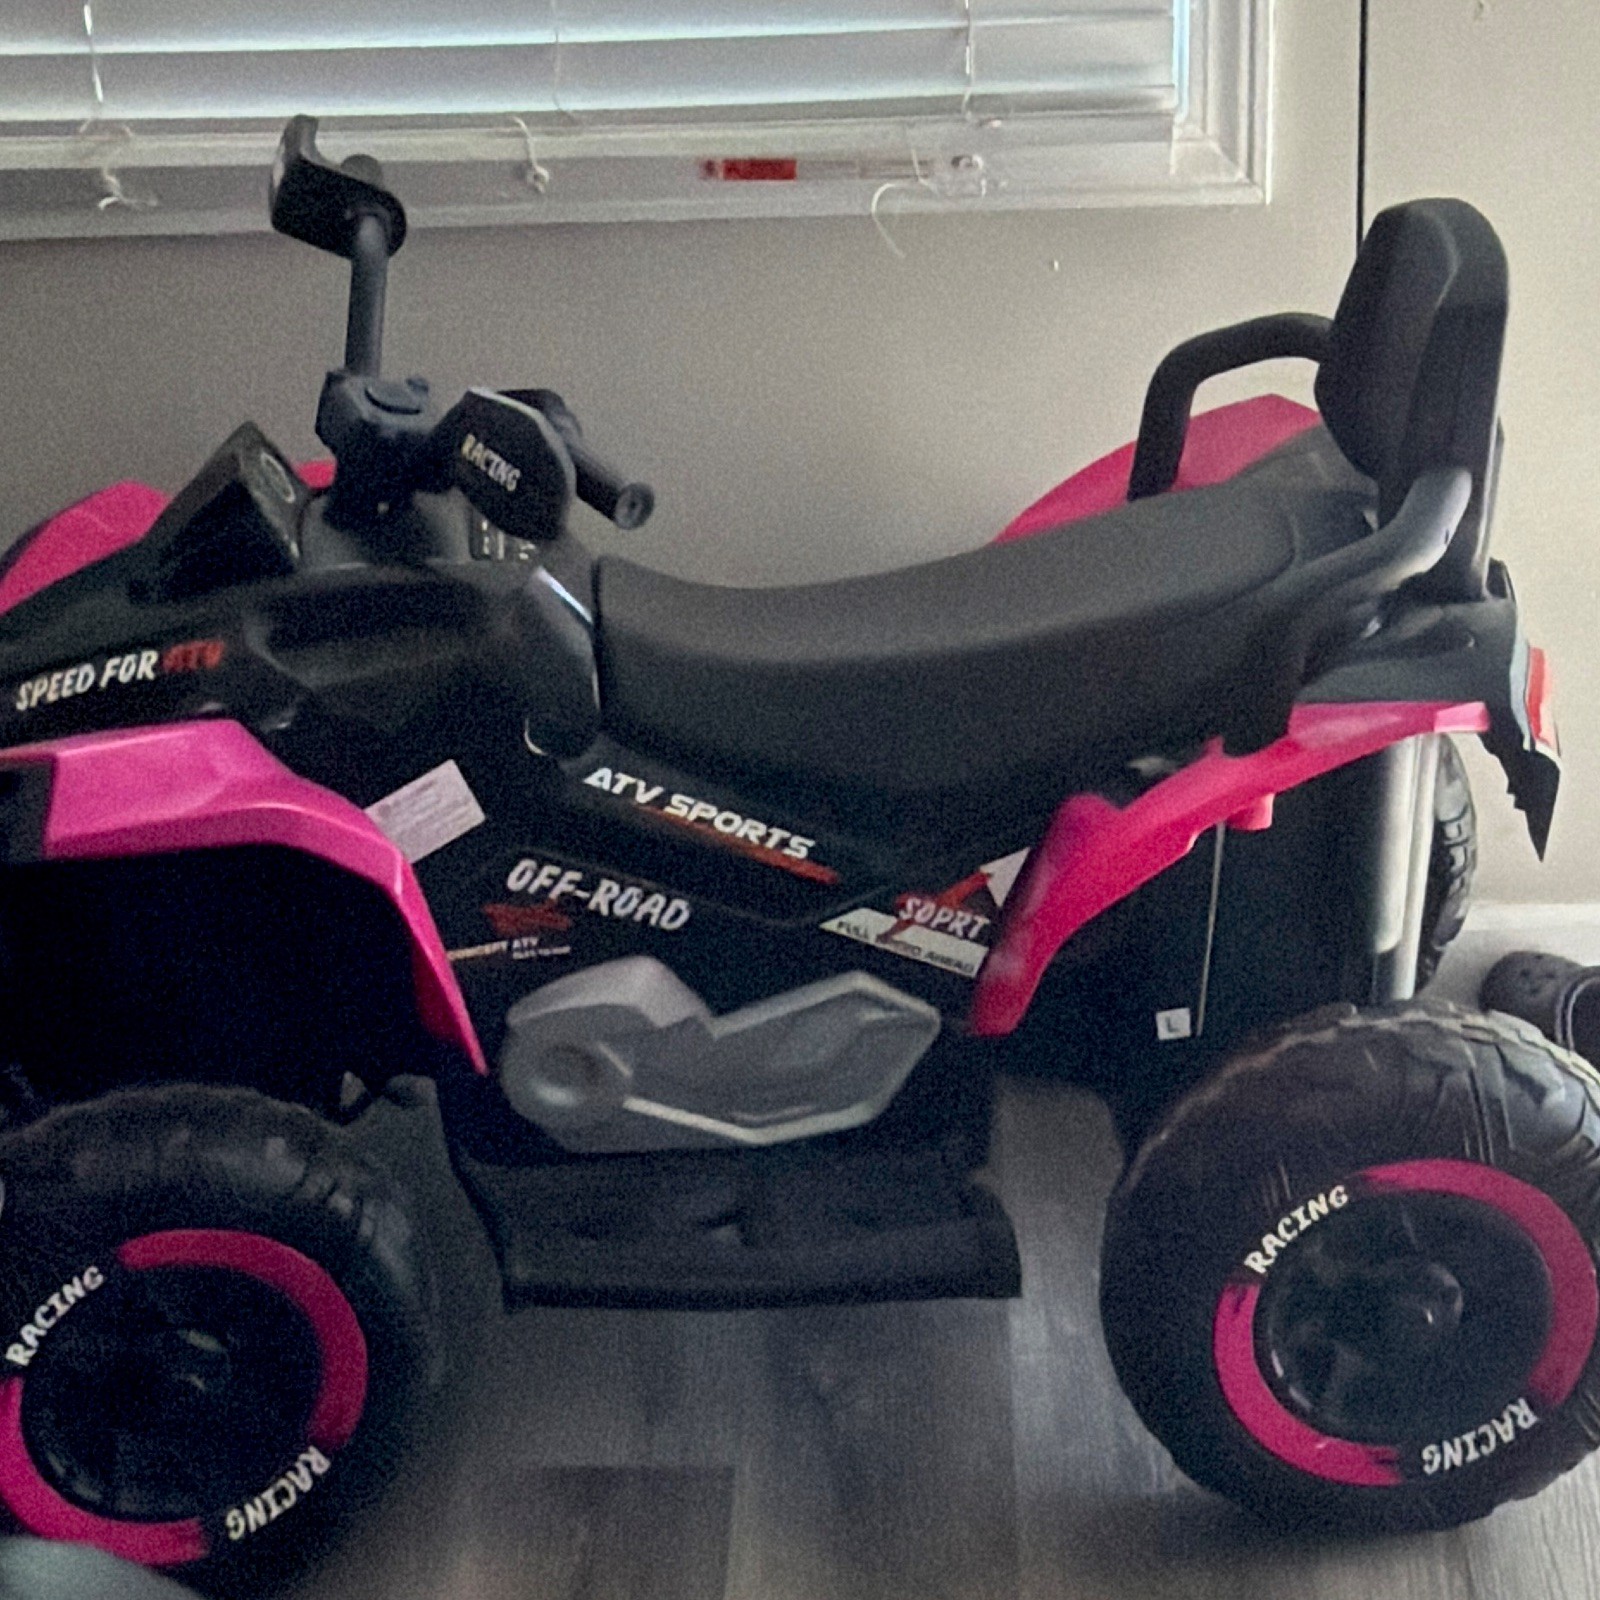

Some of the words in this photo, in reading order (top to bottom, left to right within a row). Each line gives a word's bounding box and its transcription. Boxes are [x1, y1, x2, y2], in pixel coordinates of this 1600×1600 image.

[462, 433, 521, 492] RACING
[16, 663, 95, 711] SPEED
[100, 650, 158, 688] FOR
[583, 767, 664, 804] ATV
[663, 793, 816, 860] SPORTS
[506, 858, 690, 931] OFF-ROAD
[899, 897, 991, 939] SOPRT
[1243, 1184, 1349, 1274] RACING
[5, 1265, 104, 1367] RACING
[1421, 1397, 1538, 1475] RACING
[225, 1445, 331, 1541] RACING
